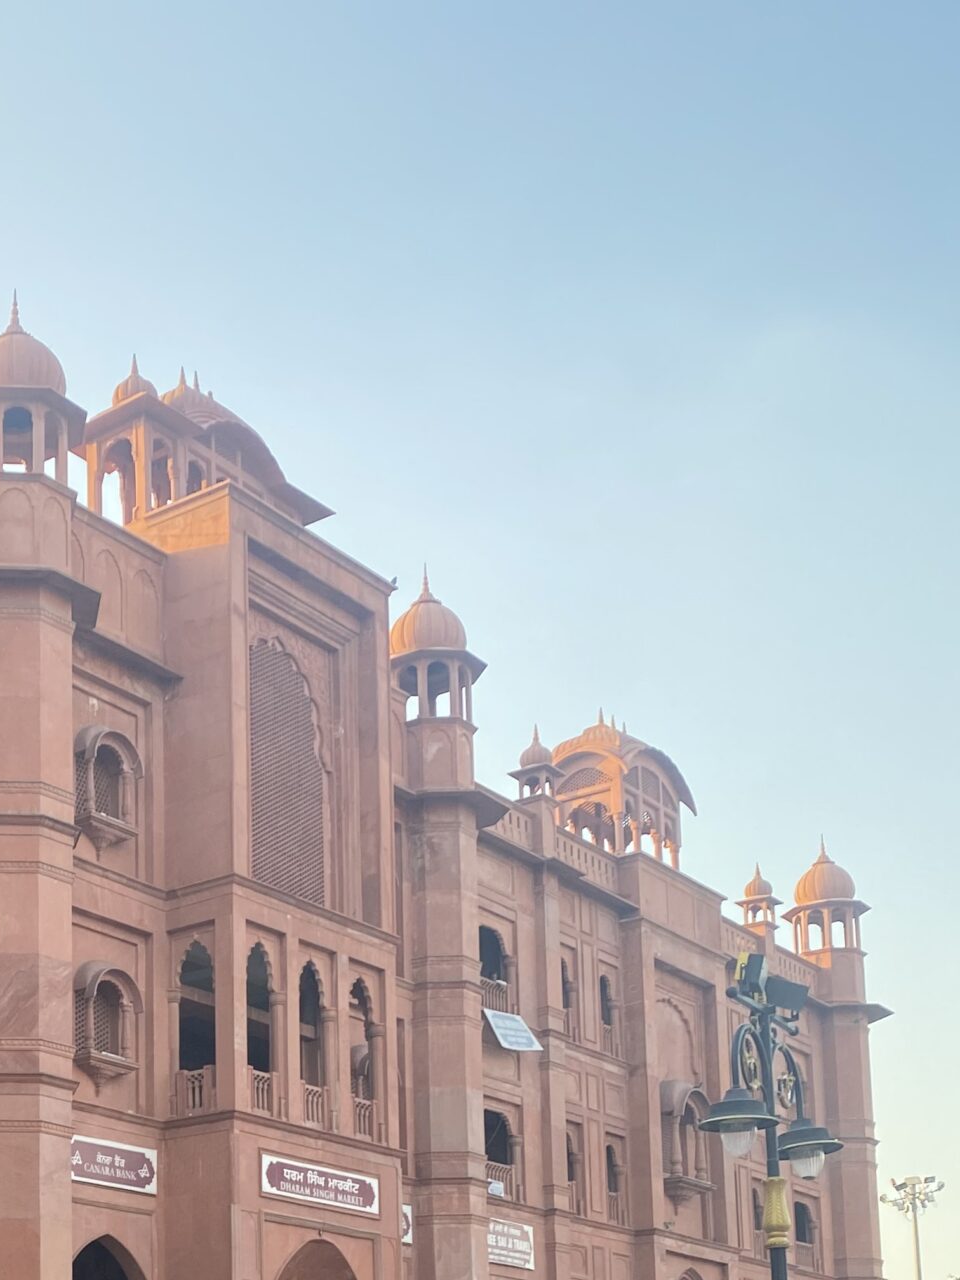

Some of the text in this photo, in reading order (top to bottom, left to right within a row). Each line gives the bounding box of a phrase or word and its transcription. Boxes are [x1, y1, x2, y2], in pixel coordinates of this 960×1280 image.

[83, 1162, 137, 1181] CANARA BANK
[280, 1180, 364, 1207] DHARAM SINGH MARKET
